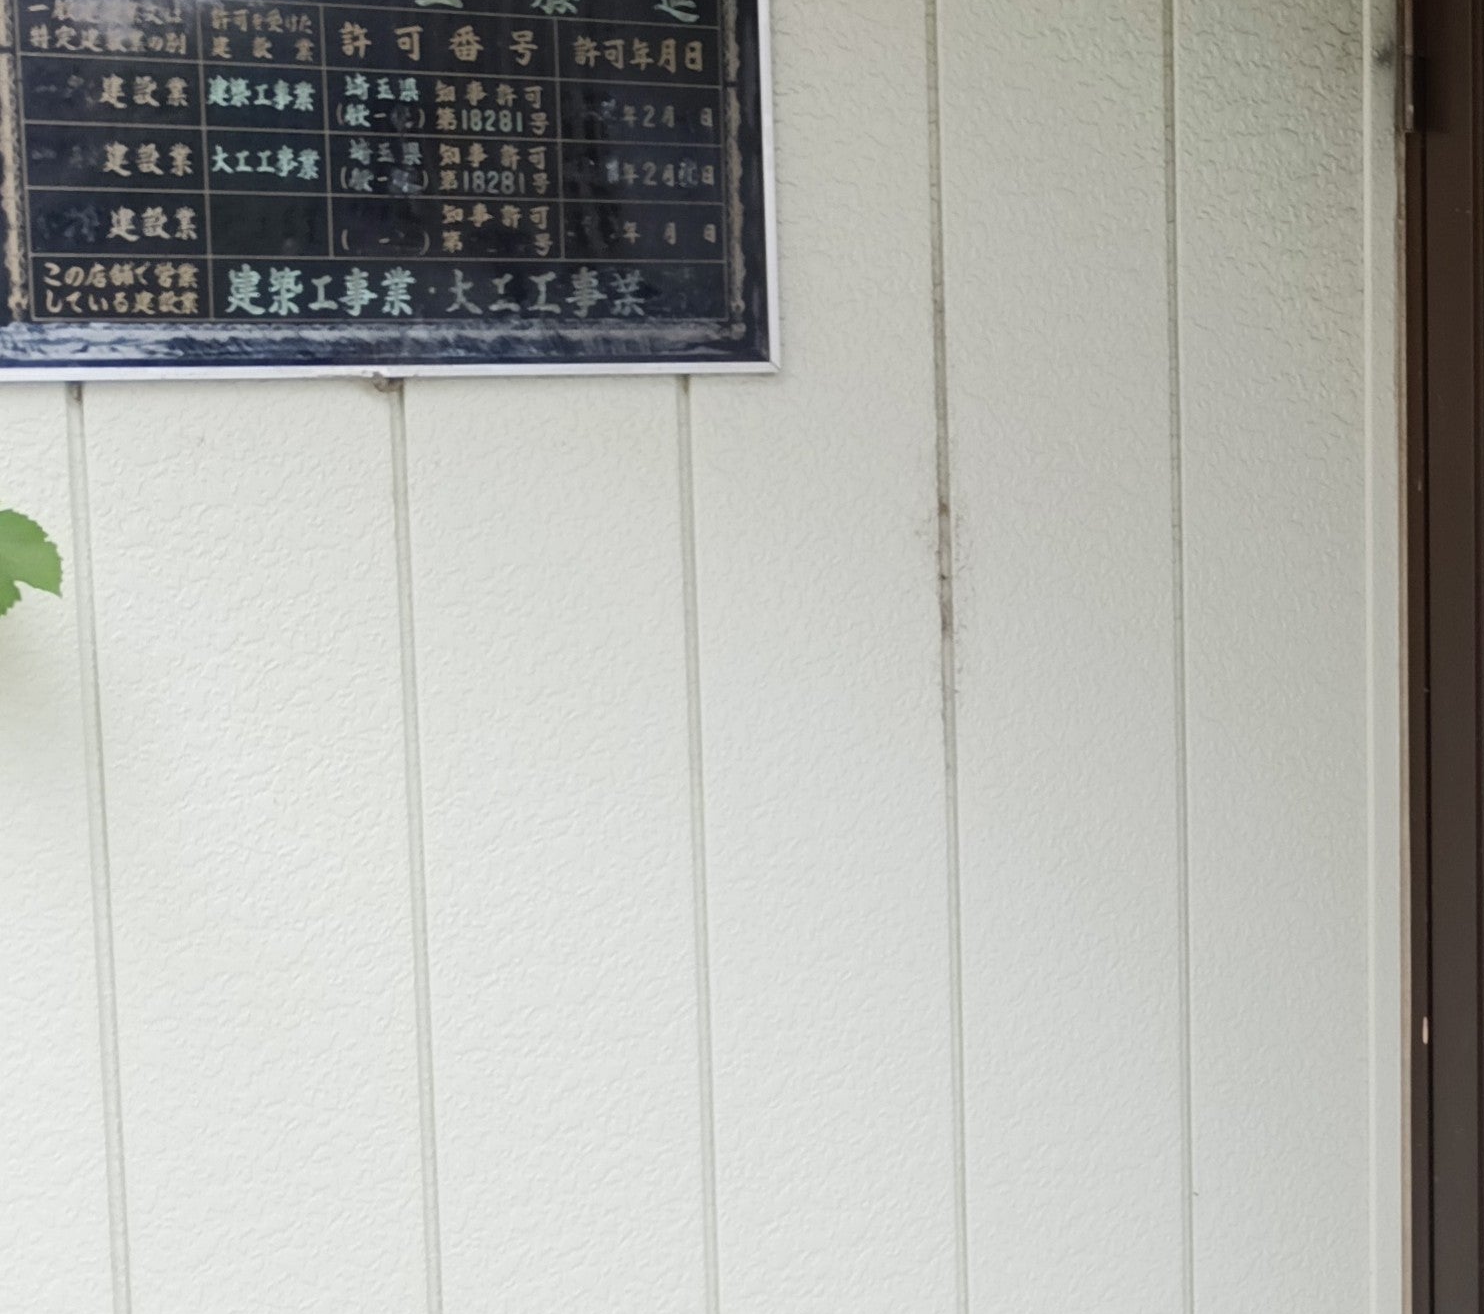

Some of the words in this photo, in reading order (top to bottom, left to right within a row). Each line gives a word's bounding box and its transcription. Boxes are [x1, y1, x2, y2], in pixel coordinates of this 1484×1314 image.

[338, 20, 538, 67] 許可番号
[573, 34, 704, 73] 許可年月日
[207, 75, 316, 112] 建築工事業
[211, 145, 320, 180] 大工工事業
